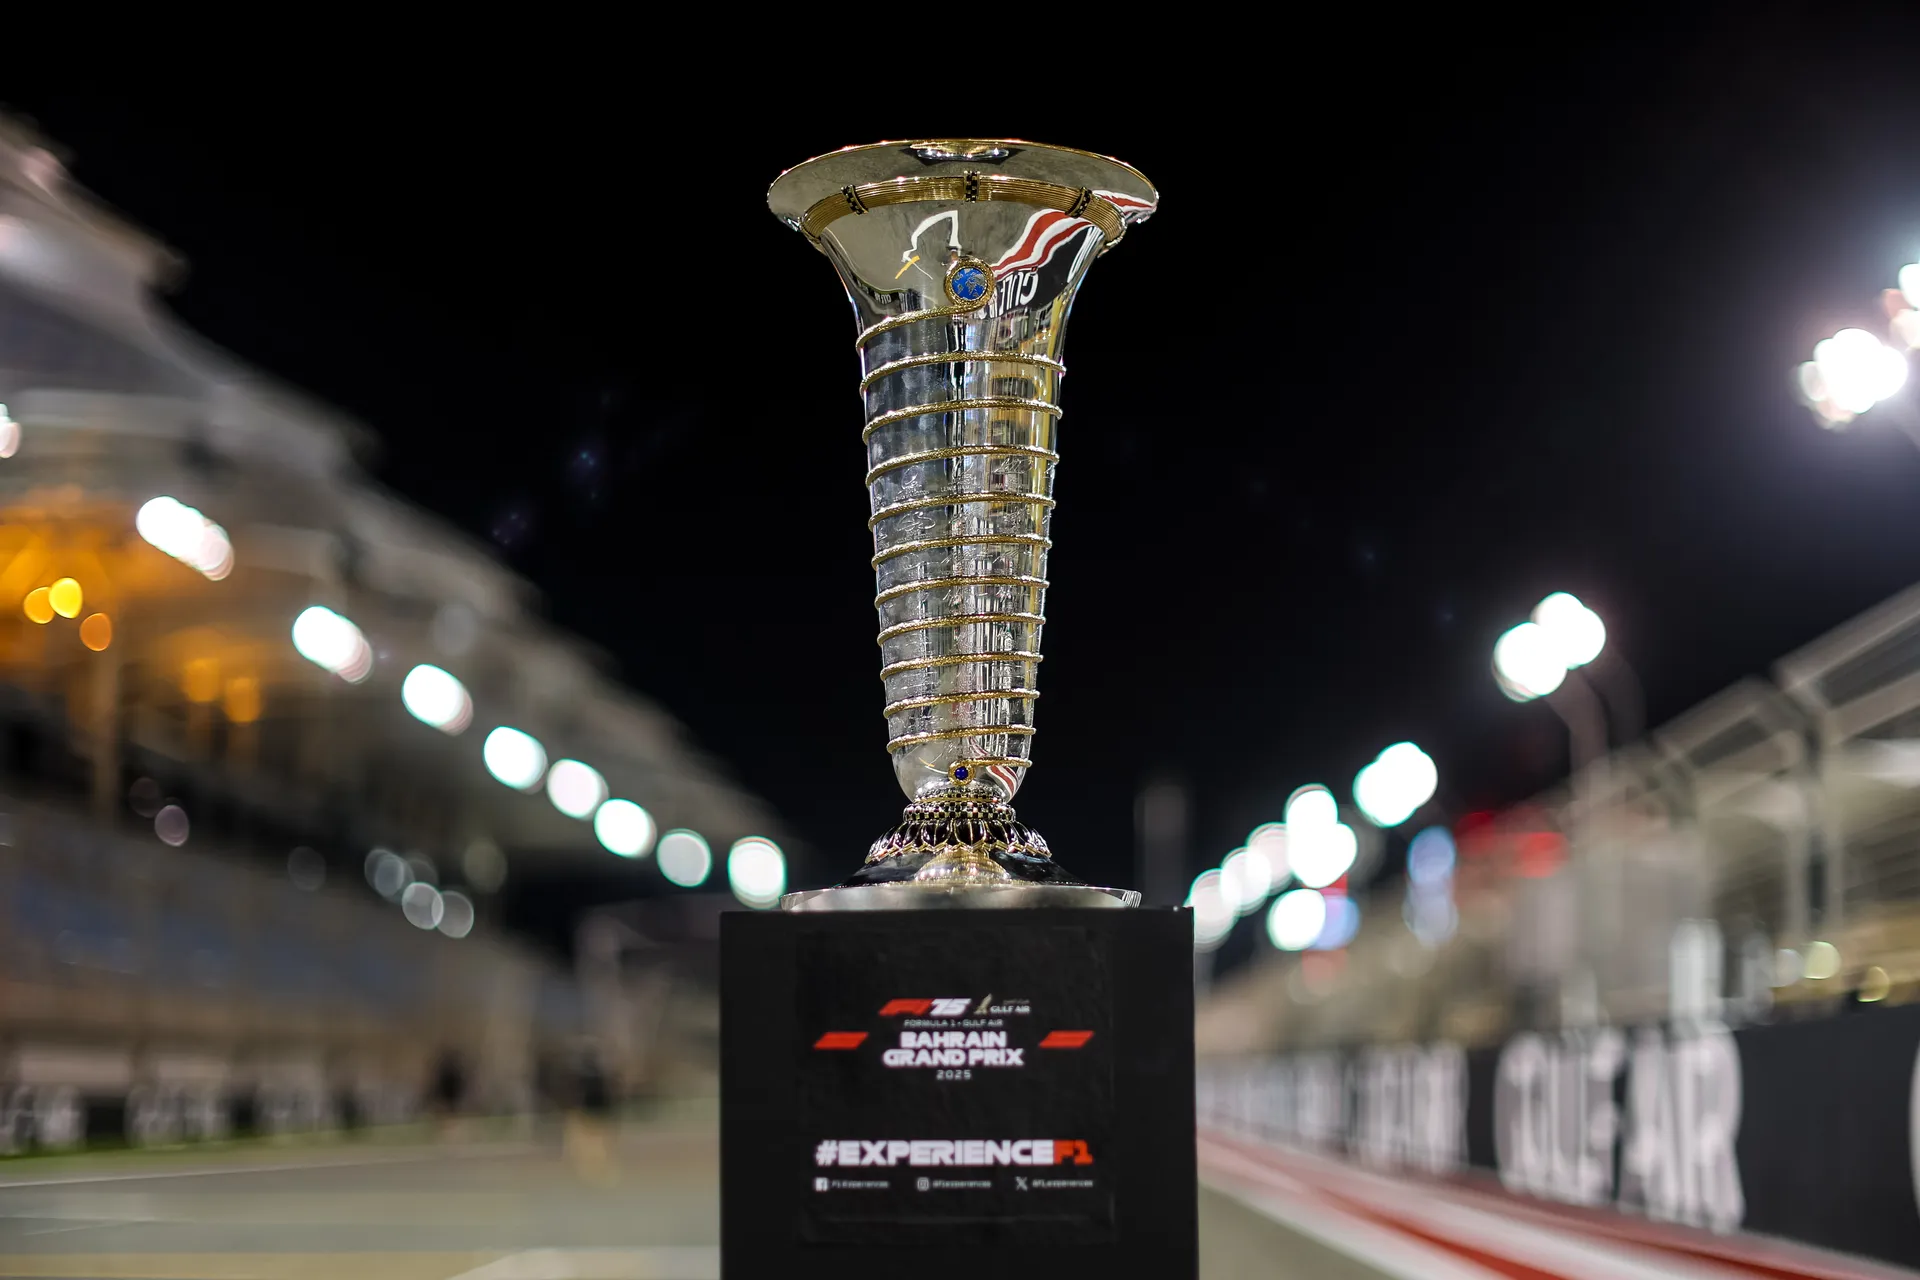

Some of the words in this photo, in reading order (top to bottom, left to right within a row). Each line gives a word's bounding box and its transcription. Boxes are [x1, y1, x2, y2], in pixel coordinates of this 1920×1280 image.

[990, 1005, 1014, 1014] GULF
[1014, 1005, 1031, 1014] AIR
[903, 1018, 948, 1028] FORMULA
[962, 1018, 987, 1028] GULF
[987, 1018, 1004, 1028] AIR
[900, 1030, 1007, 1049] BAHRAIN
[882, 1049, 966, 1067] GRAND
[967, 1048, 1025, 1067] PRIX
[936, 1069, 972, 1081] 2025
[815, 1139, 1093, 1166] #EXPERIENCEF1
